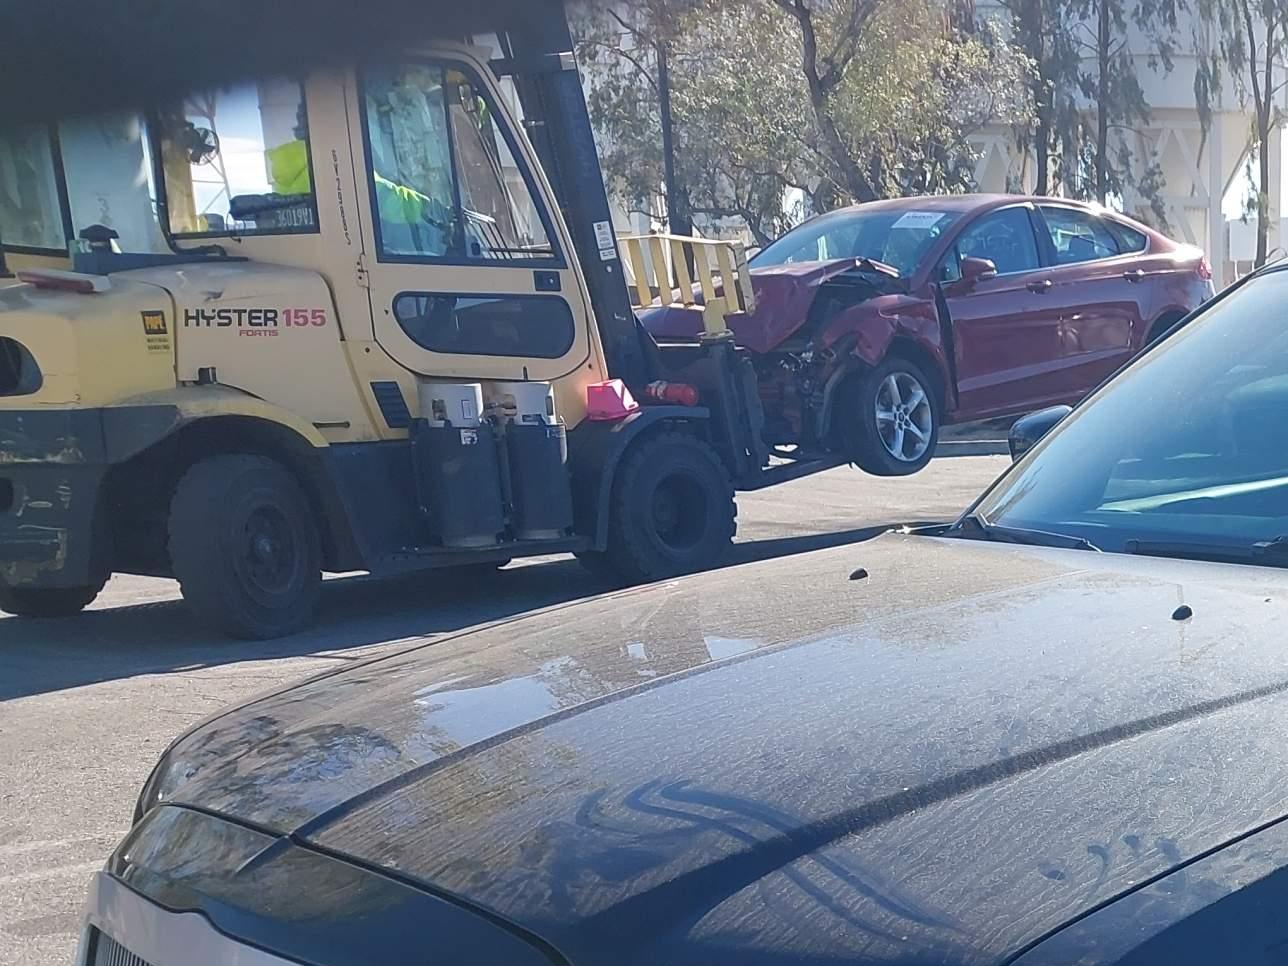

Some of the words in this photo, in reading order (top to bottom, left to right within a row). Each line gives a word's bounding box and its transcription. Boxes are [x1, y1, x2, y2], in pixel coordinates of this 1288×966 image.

[184, 308, 278, 327] HYSTER
[282, 309, 326, 327] 155
[239, 329, 279, 337] FORTIS
